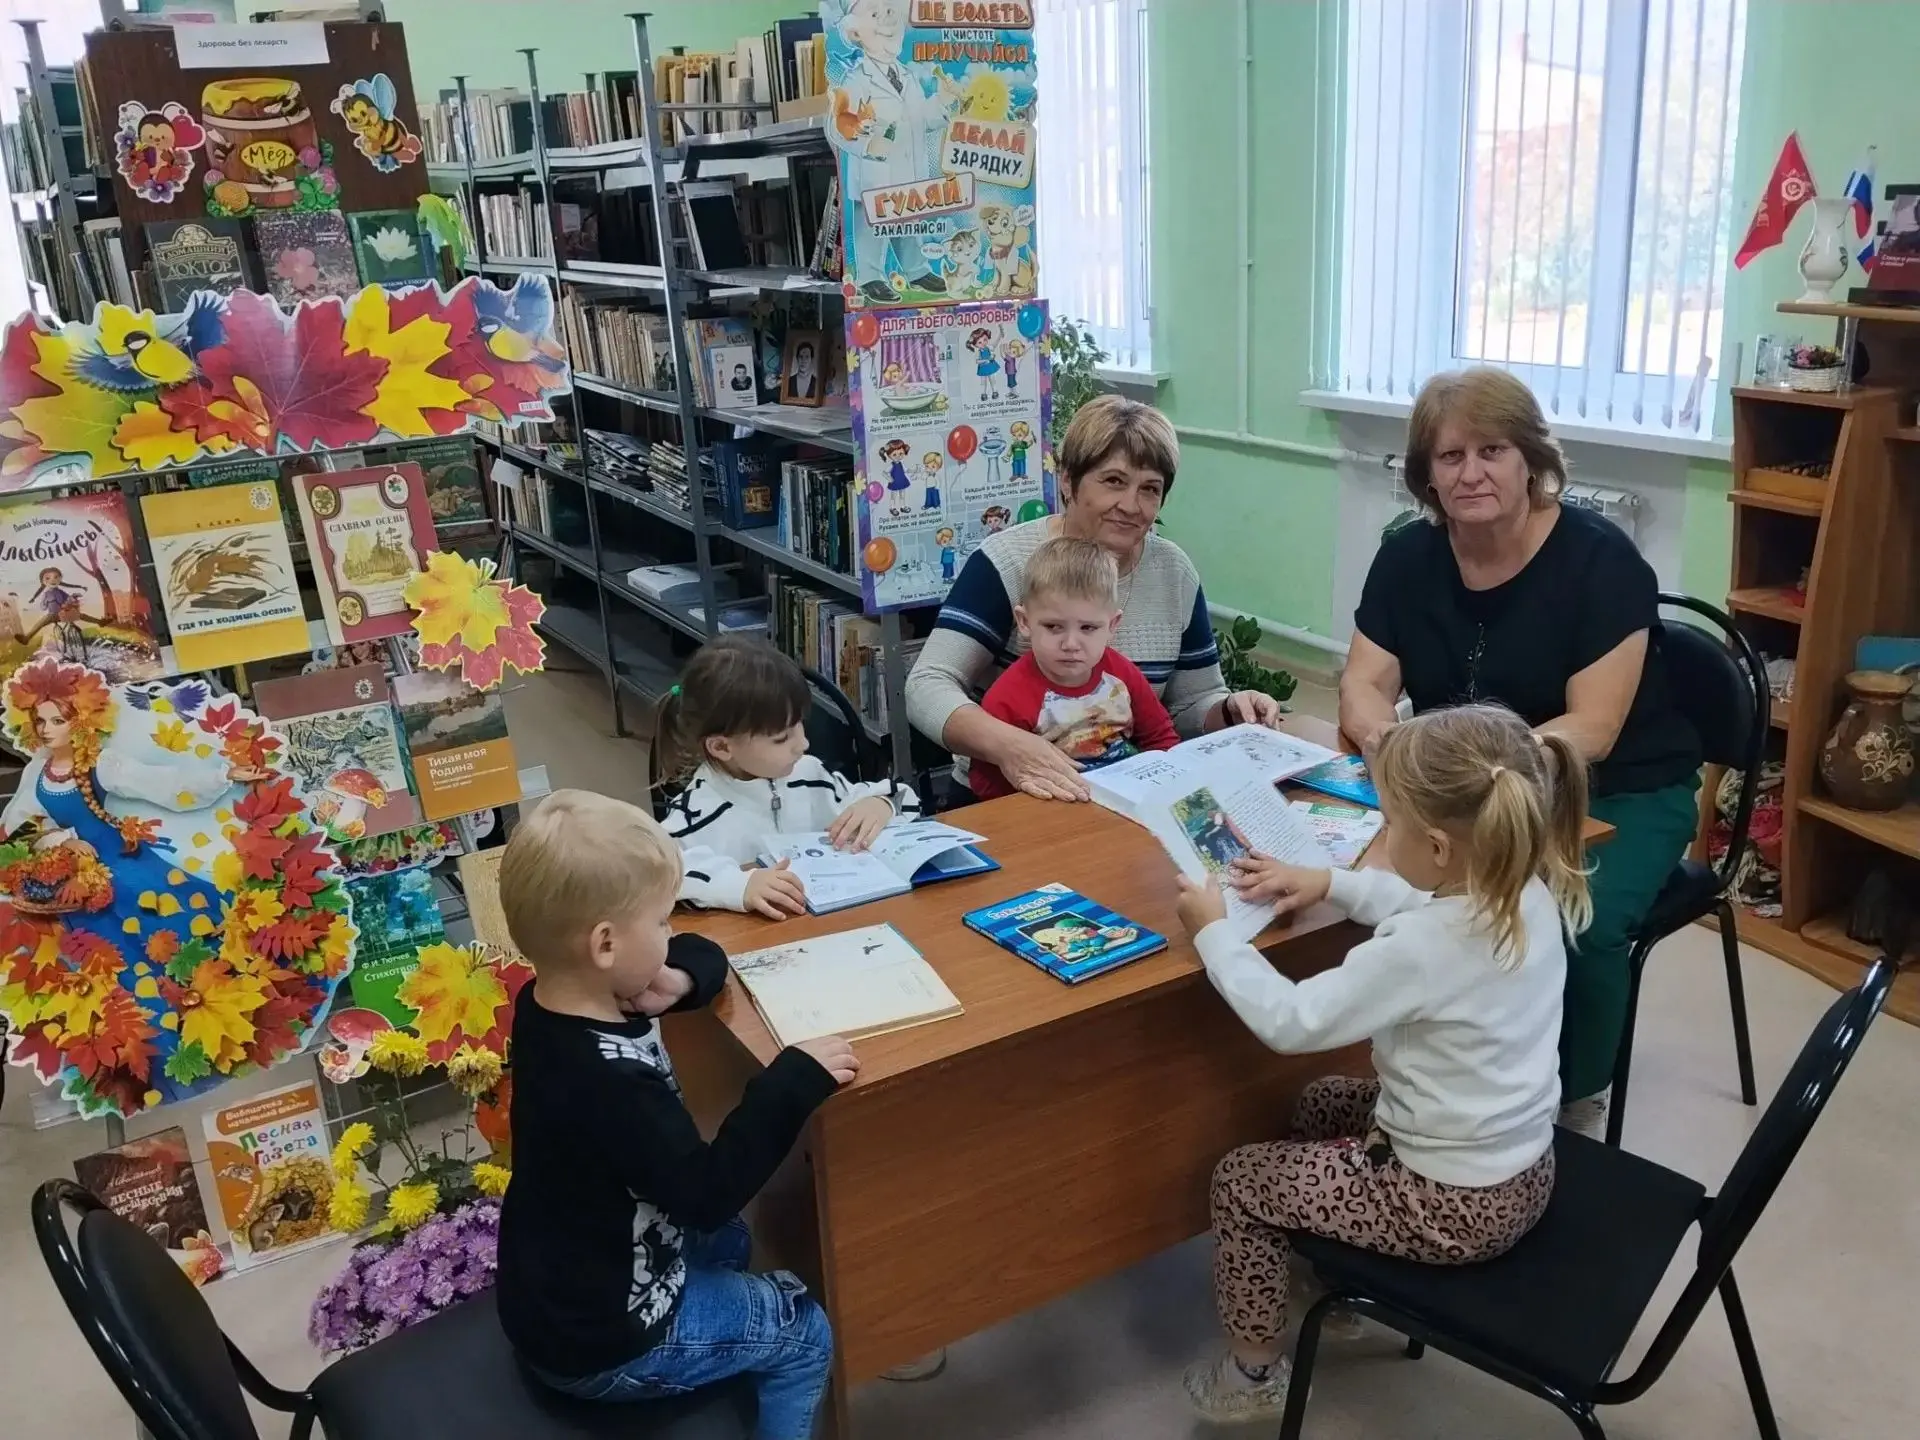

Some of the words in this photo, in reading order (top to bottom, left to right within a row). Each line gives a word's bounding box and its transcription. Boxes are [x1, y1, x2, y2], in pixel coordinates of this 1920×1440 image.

[918, 1, 946, 20] НЕ
[197, 40, 236, 48] Здоровье
[943, 30, 950, 40] К
[953, 30, 994, 40] ЧИСТОТЕ
[913, 40, 1029, 63] ПРИУЧАЙСЯ
[950, 122, 1025, 155] ДЕЛАЙ
[250, 145, 286, 169] Мёд
[950, 148, 1023, 177] ЗАРЯДКУ,
[875, 176, 967, 217] ГУЛЯЙ,
[874, 221, 946, 236] ЗАКАЛЯЙСЯ!
[168, 260, 231, 278] ДОКТОР
[882, 319, 906, 333] ДЛЯ
[910, 315, 954, 329] ТВОЕГО
[957, 309, 1016, 327] ЗДОРОВЬЯ
[329, 519, 371, 533] СЛАВНАЯ
[375, 515, 405, 526] ОСЕНЬ
[428, 752, 462, 767] Тихая
[464, 748, 487, 760] моя
[430, 762, 474, 779] Родина
[364, 963, 419, 983] Стихотвор
[225, 1099, 283, 1121] Библиотека
[239, 1120, 312, 1153] Лесная
[113, 1185, 184, 1217] ИСШЕСТВИЯ
